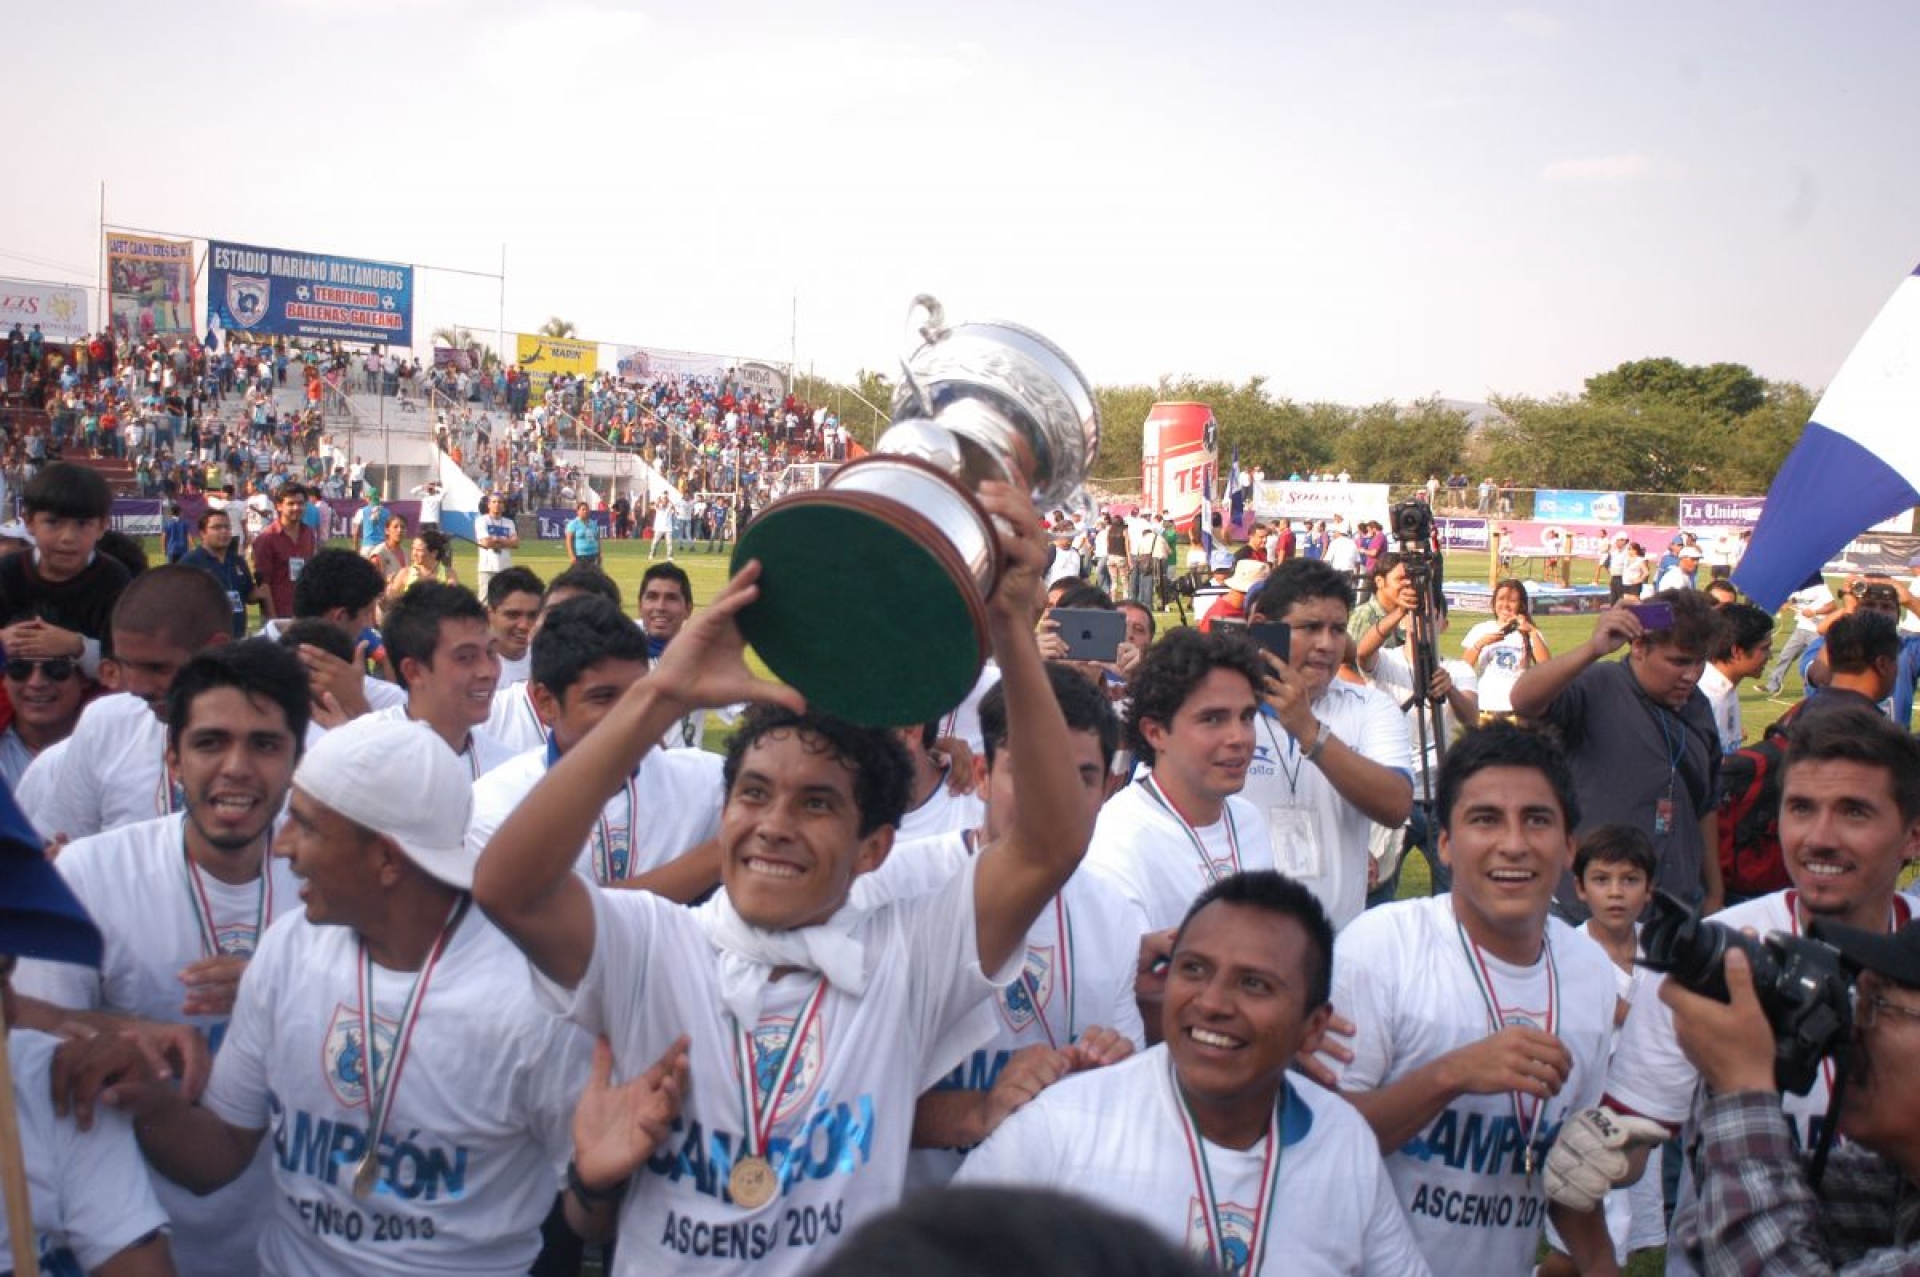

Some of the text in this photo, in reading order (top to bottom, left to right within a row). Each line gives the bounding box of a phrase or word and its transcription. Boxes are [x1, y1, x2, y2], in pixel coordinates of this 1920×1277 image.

[215, 247, 268, 274] ESTADIO
[271, 255, 328, 281] MARIANO
[330, 263, 404, 291] MATAMOROS
[313, 285, 380, 307] TERRITORIO
[286, 302, 403, 330] BALLENAS GALEANA
[1682, 503, 1702, 518] La
[539, 516, 561, 537] La
[270, 1092, 469, 1201] AMPEÓN
[1514, 1194, 1548, 1230] 201
[372, 1213, 436, 1242] 2013
